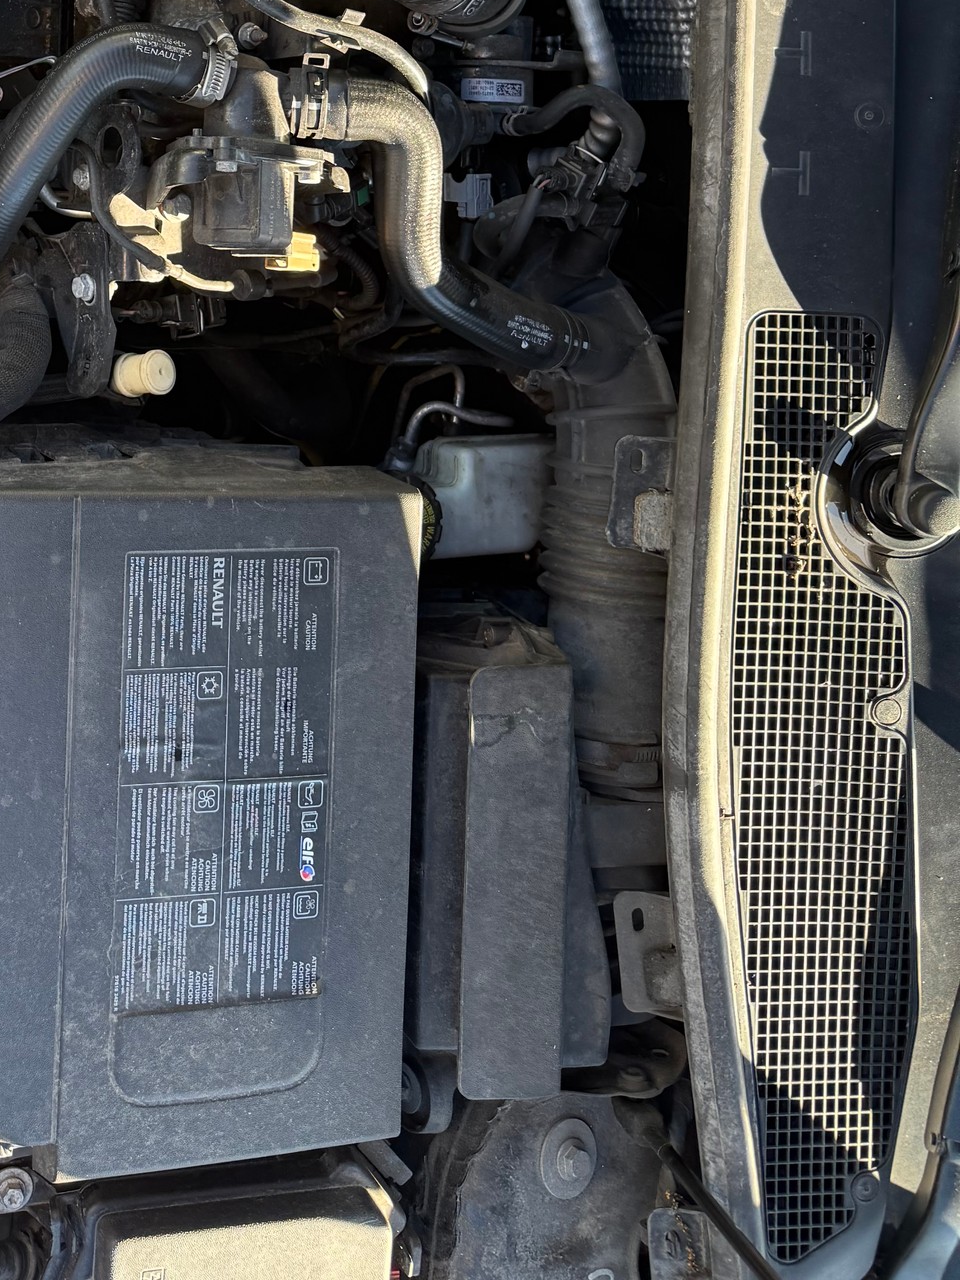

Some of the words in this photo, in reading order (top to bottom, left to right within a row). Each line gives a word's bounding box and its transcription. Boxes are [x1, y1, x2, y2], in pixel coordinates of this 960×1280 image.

[136, 45, 184, 61] RENAULT
[212, 557, 225, 629] RENAULT
[302, 837, 314, 865] elf
